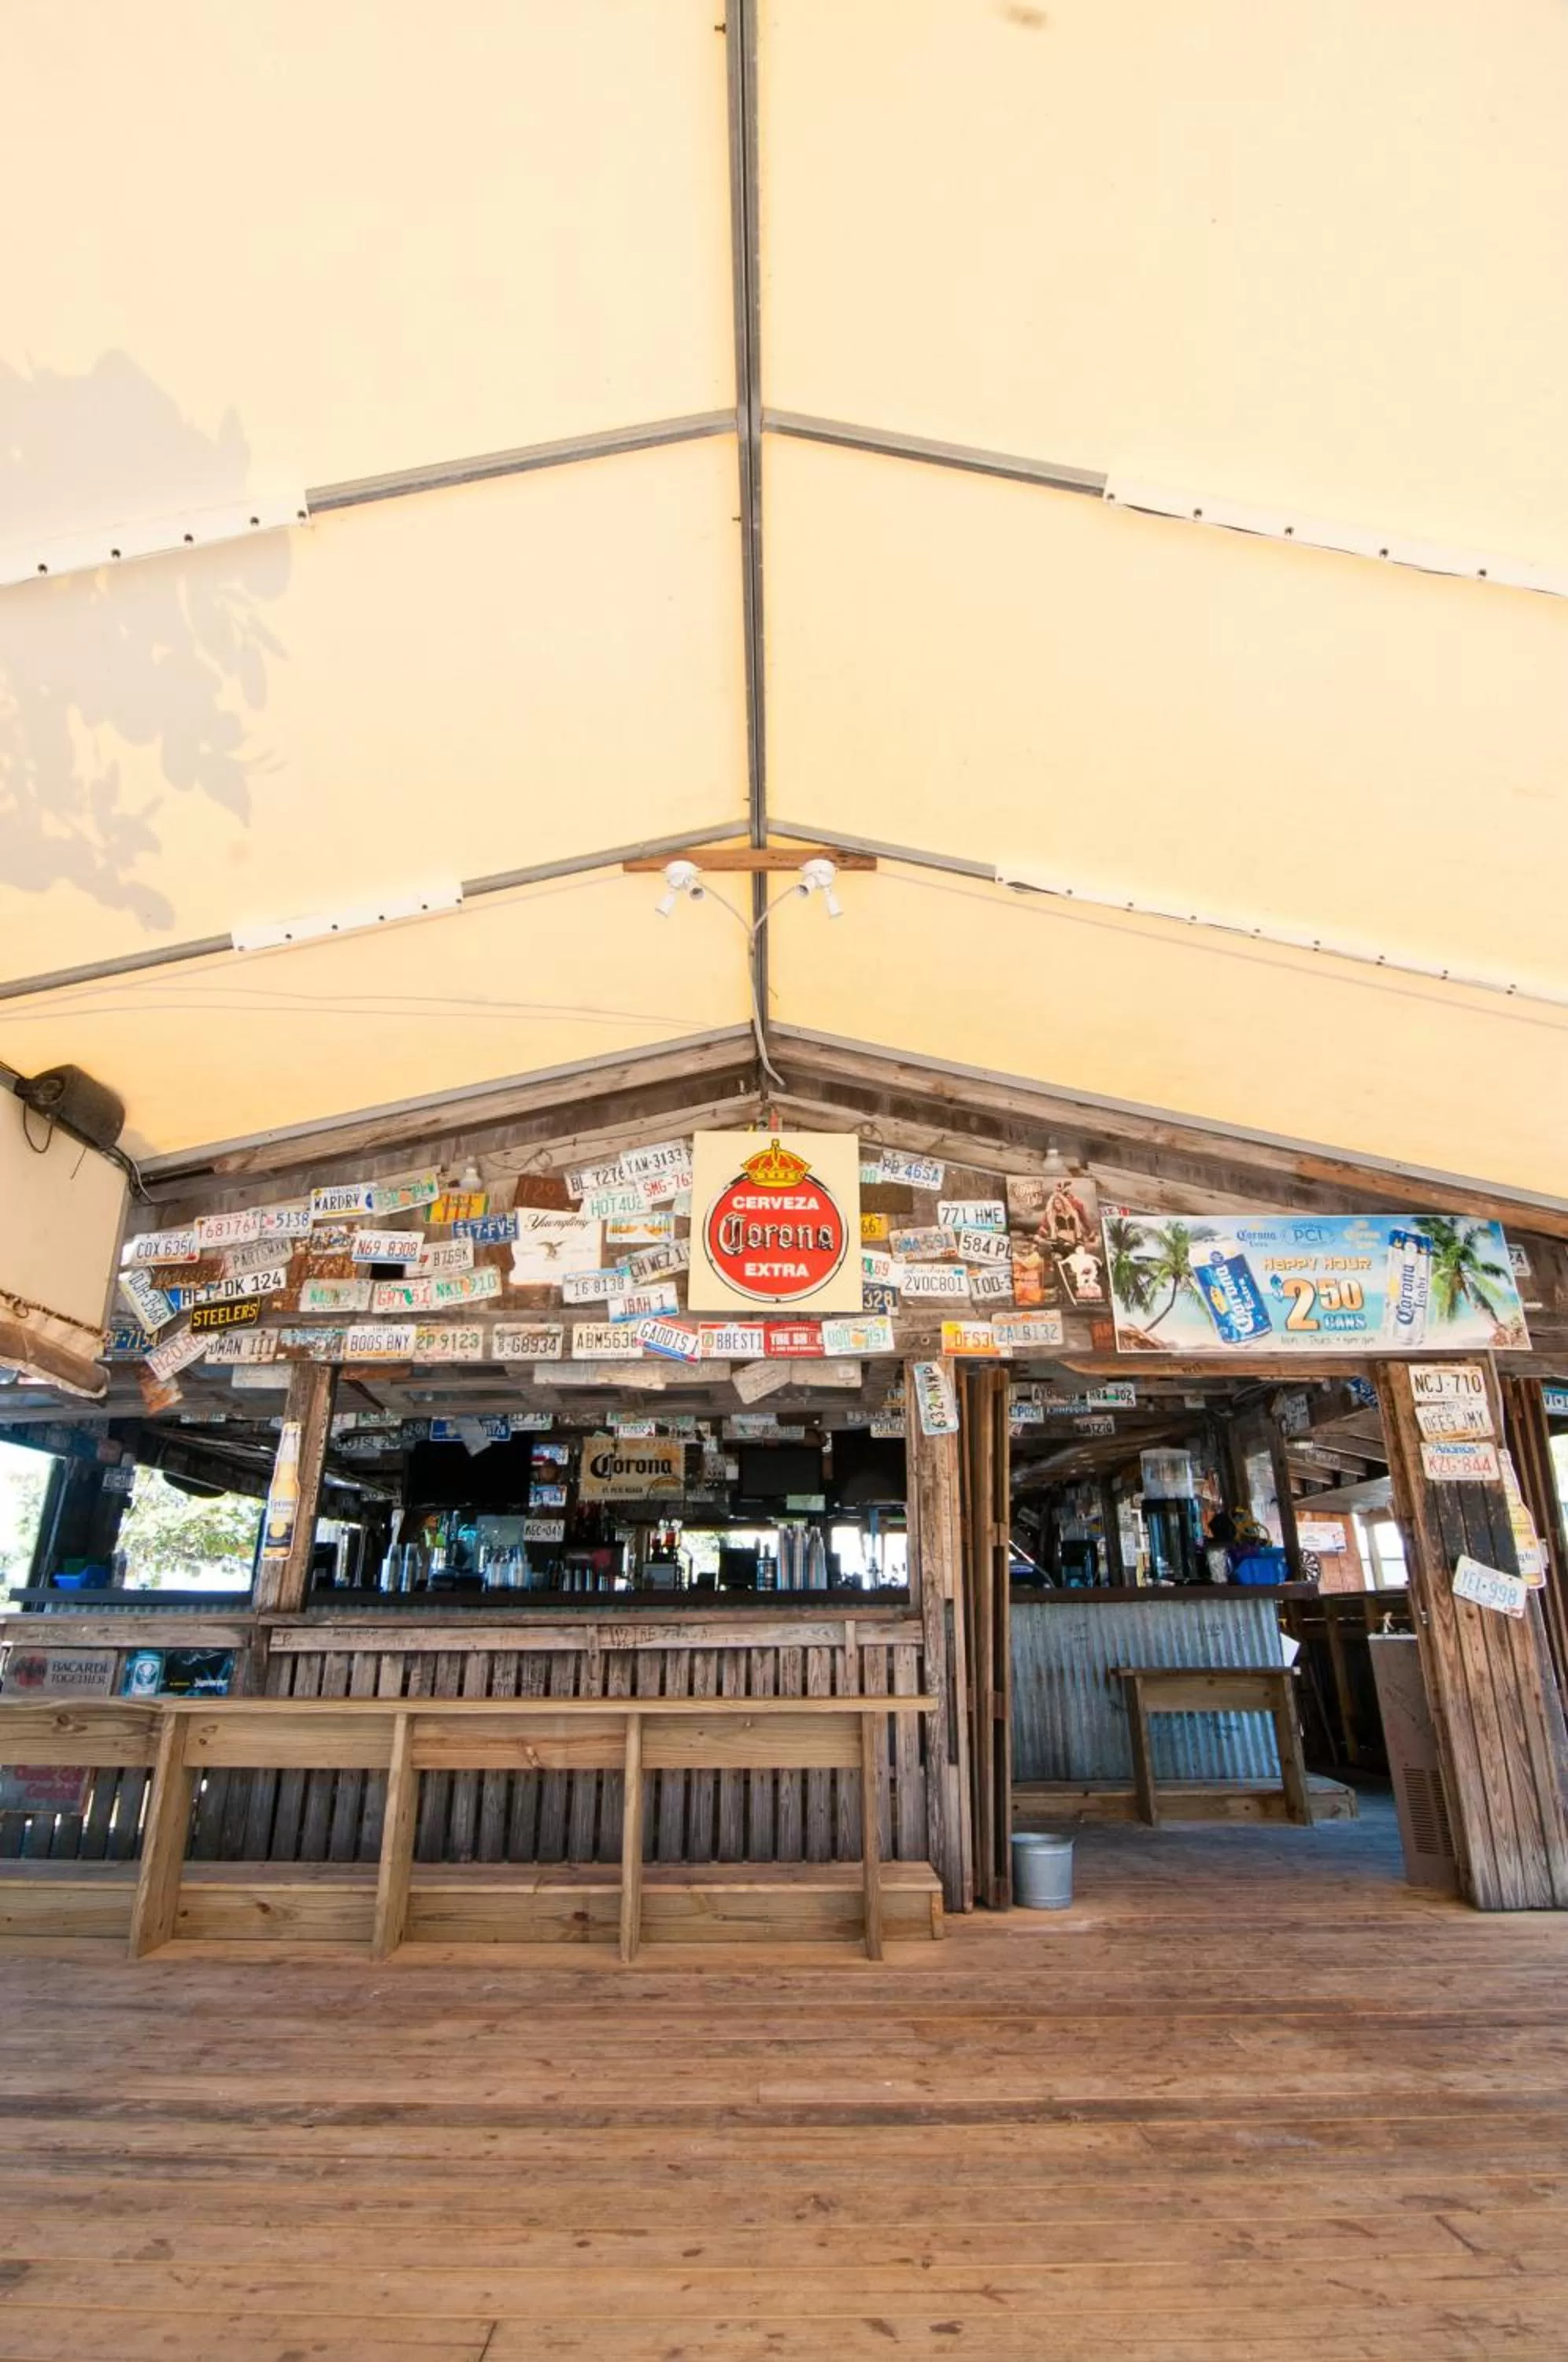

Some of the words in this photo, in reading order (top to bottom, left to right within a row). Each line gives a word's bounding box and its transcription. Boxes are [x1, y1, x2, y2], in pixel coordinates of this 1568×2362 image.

[731, 1196, 819, 1211] CERVEZA
[718, 1211, 834, 1256] Corona
[744, 1262, 810, 1278] EXTRA
[1263, 1257, 1318, 1272] HAPPY
[1322, 1257, 1373, 1271] HOUR
[224, 1280, 245, 1297] DK
[251, 1271, 283, 1292] 124
[191, 1301, 258, 1327] STEELERS
[590, 1452, 673, 1482] Corona
[50, 1661, 109, 1673] BACARDI
